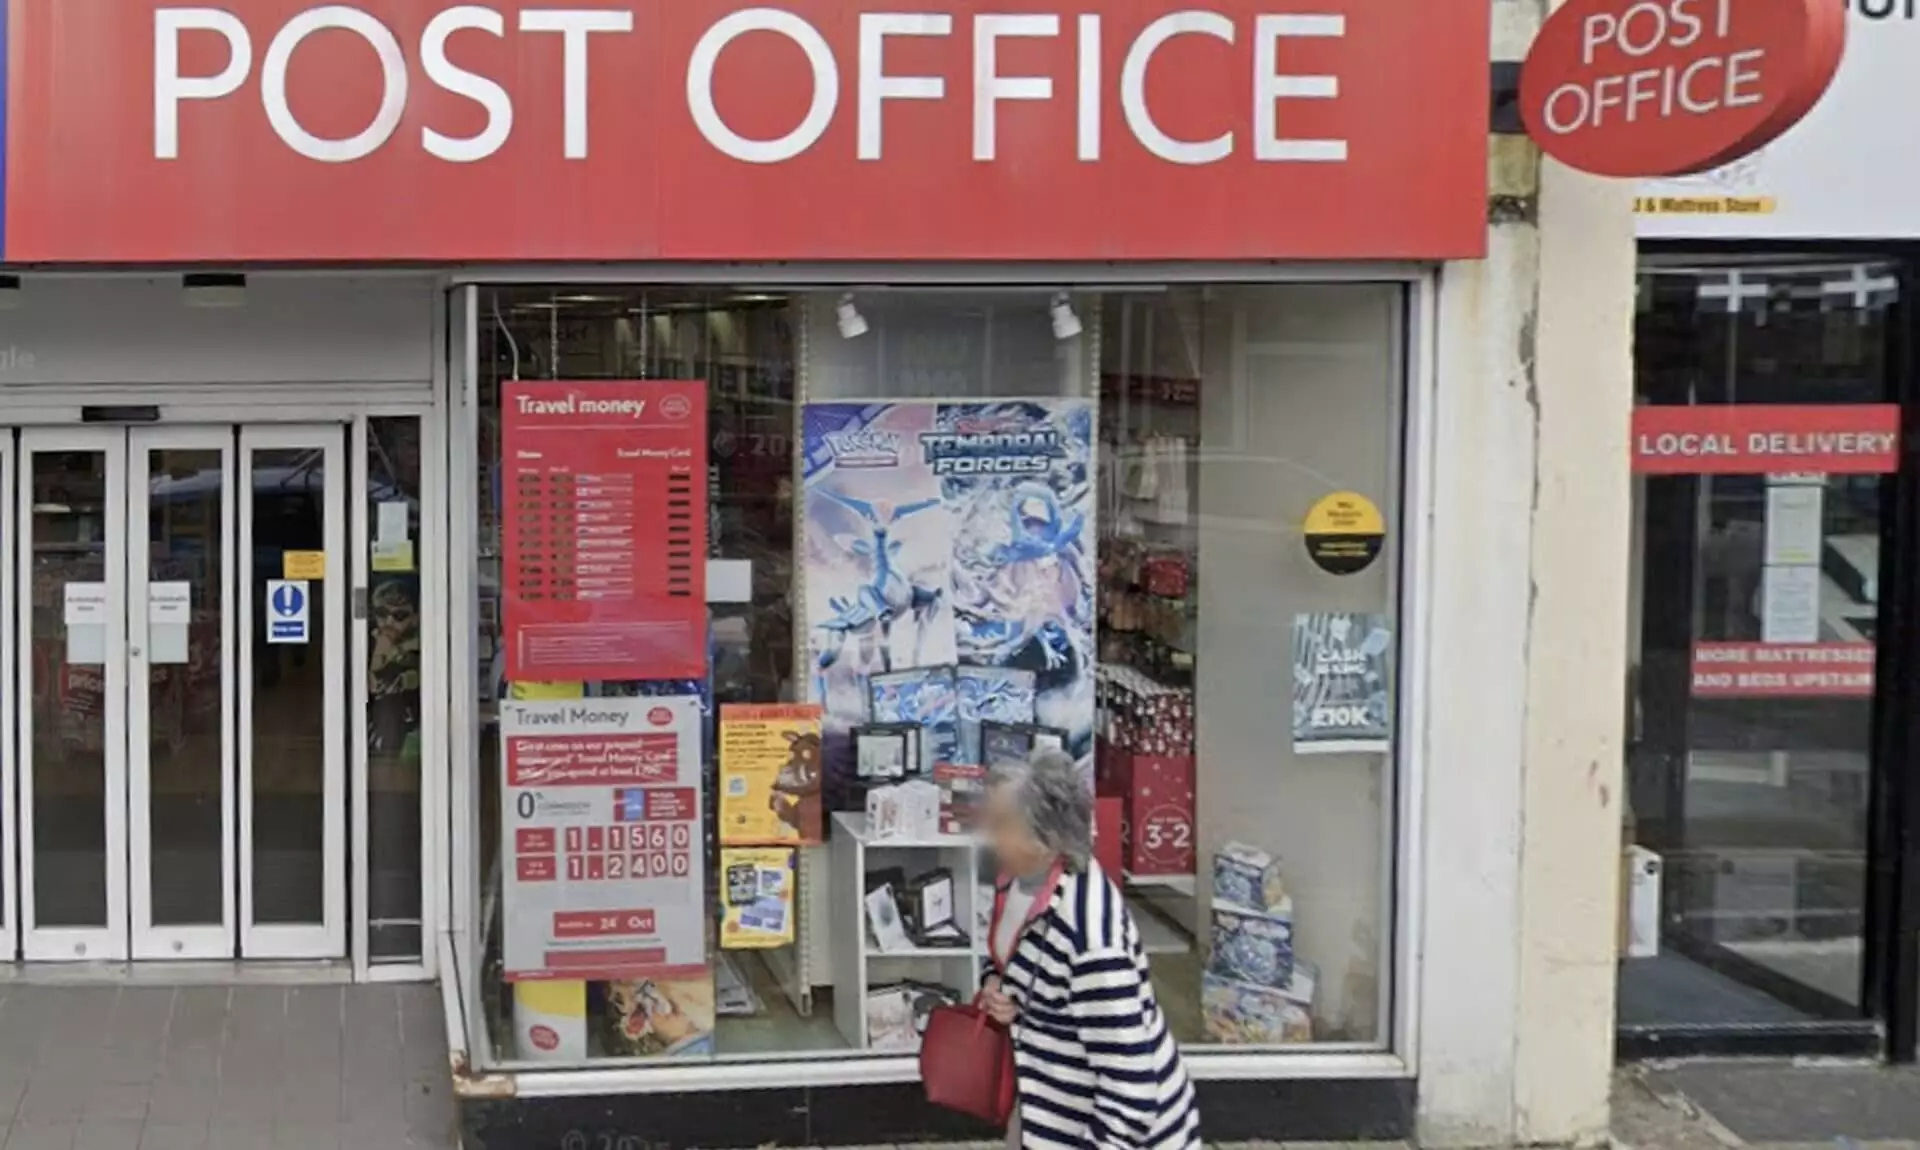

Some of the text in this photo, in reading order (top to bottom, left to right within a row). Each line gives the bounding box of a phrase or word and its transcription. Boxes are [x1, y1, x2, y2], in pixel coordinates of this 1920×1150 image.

[1583, 0, 1730, 64] POST
[152, 5, 1350, 164] POST OFFICE
[1543, 49, 1765, 135] OFFICE
[1660, 198, 1719, 213] Mattress
[1725, 197, 1760, 213] Store
[516, 394, 574, 414] Travel
[579, 400, 645, 418] money
[1639, 433, 1895, 455] LOCAL DELIVERY
[935, 456, 1050, 474] FORCES
[1754, 648, 1875, 662] MATTRESSE
[1792, 673, 1871, 687] UPSTAIR
[515, 708, 629, 726] Travel Money
[628, 915, 652, 928] Oct
